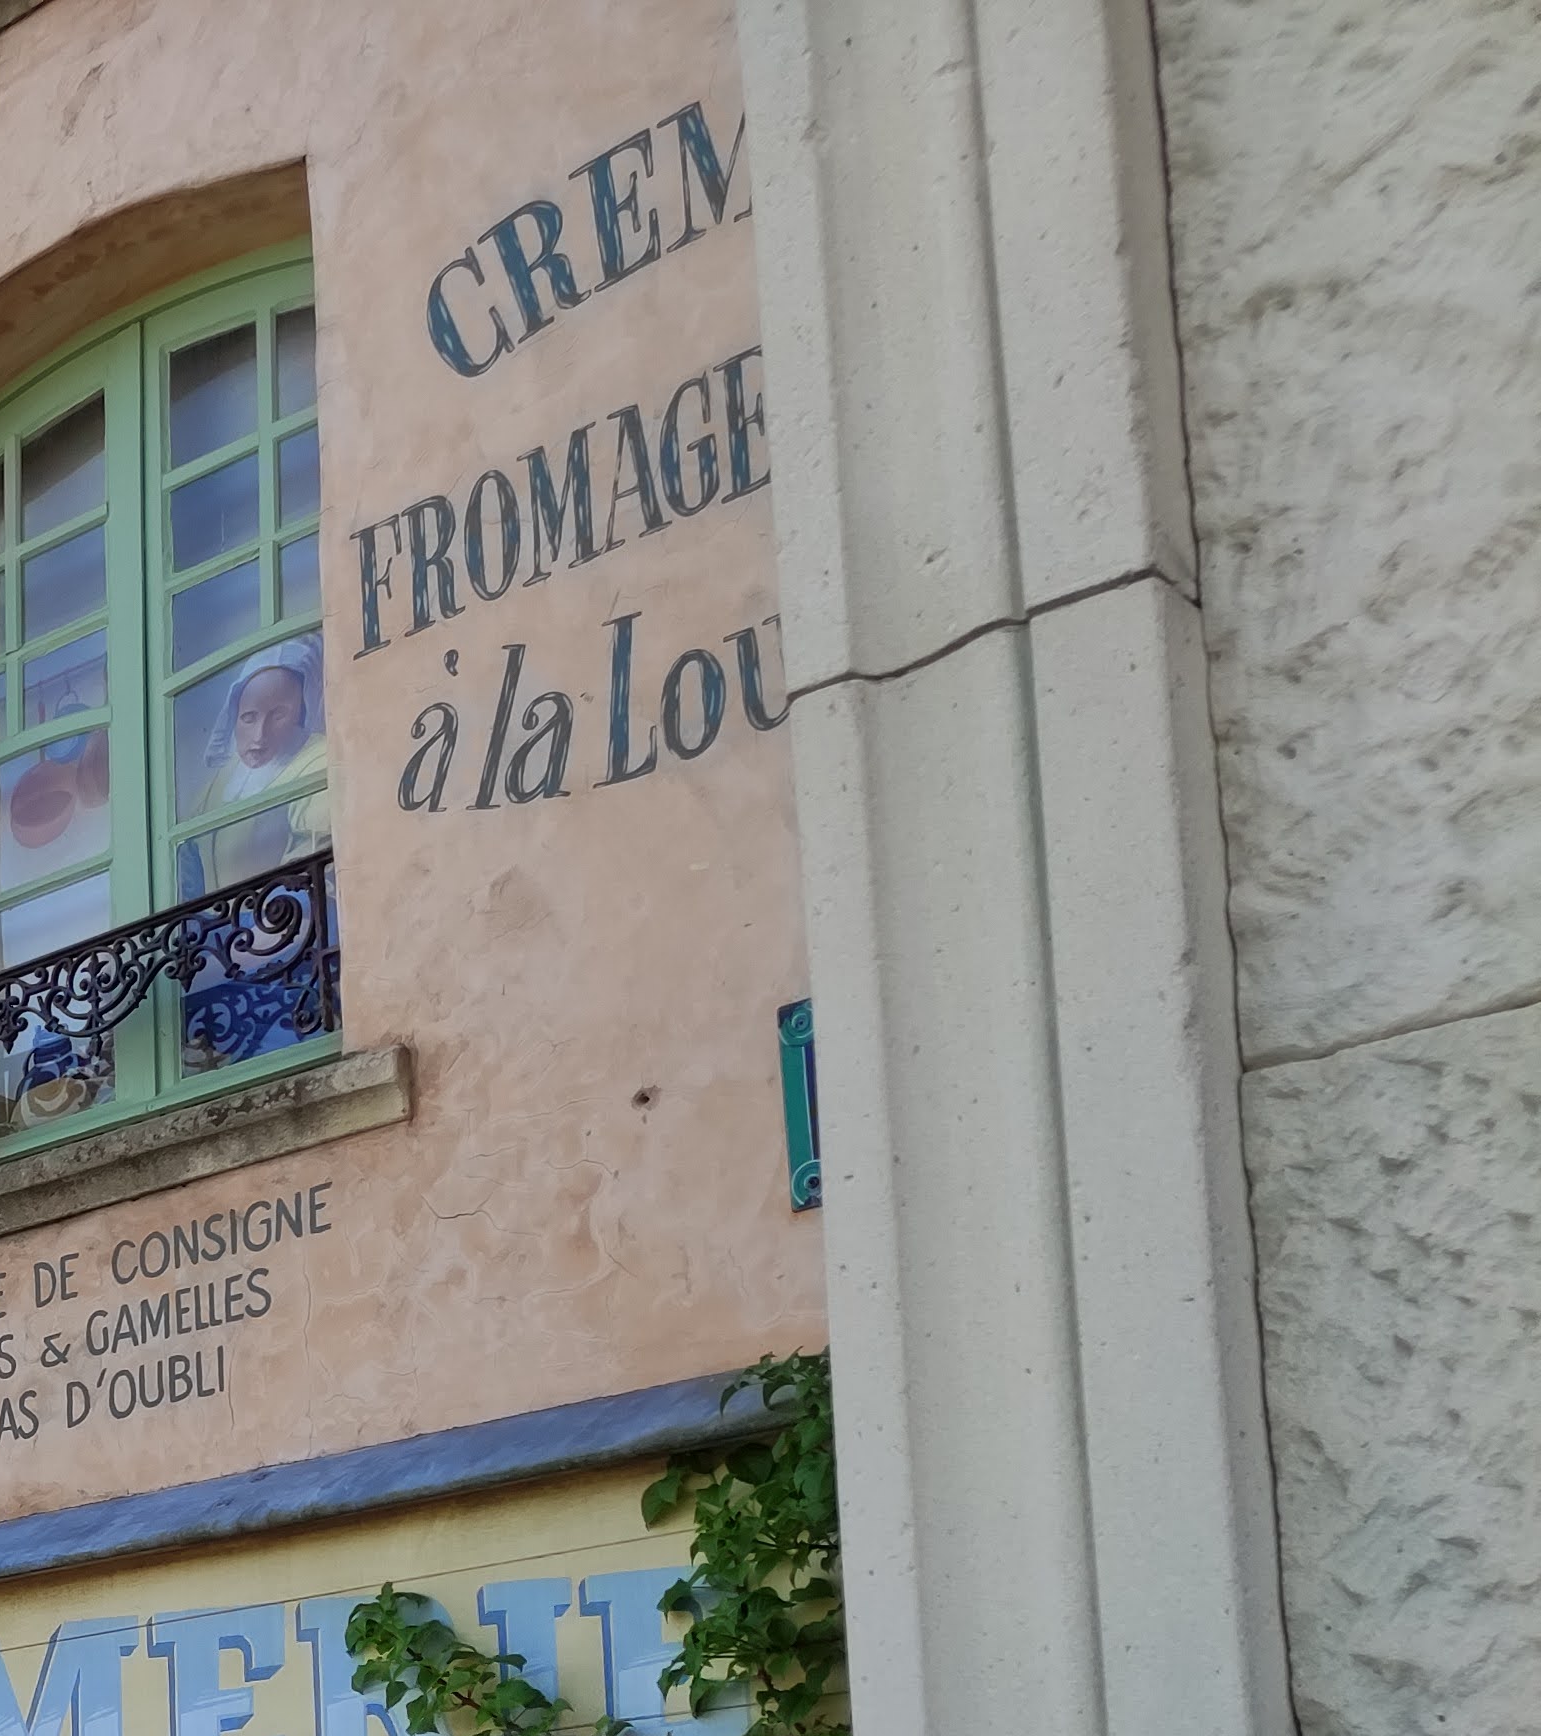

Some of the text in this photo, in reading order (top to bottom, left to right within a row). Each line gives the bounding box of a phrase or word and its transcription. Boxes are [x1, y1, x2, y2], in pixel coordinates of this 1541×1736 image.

[349, 345, 772, 660] FROMAGE
[398, 649, 458, 812] à
[467, 644, 573, 810] la
[34, 1253, 80, 1308] DE
[110, 1181, 333, 1286] CONSIGNE
[40, 1332, 70, 1368] &
[85, 1268, 273, 1356] GAMELLES
[66, 1346, 225, 1430] D'OUBLI
